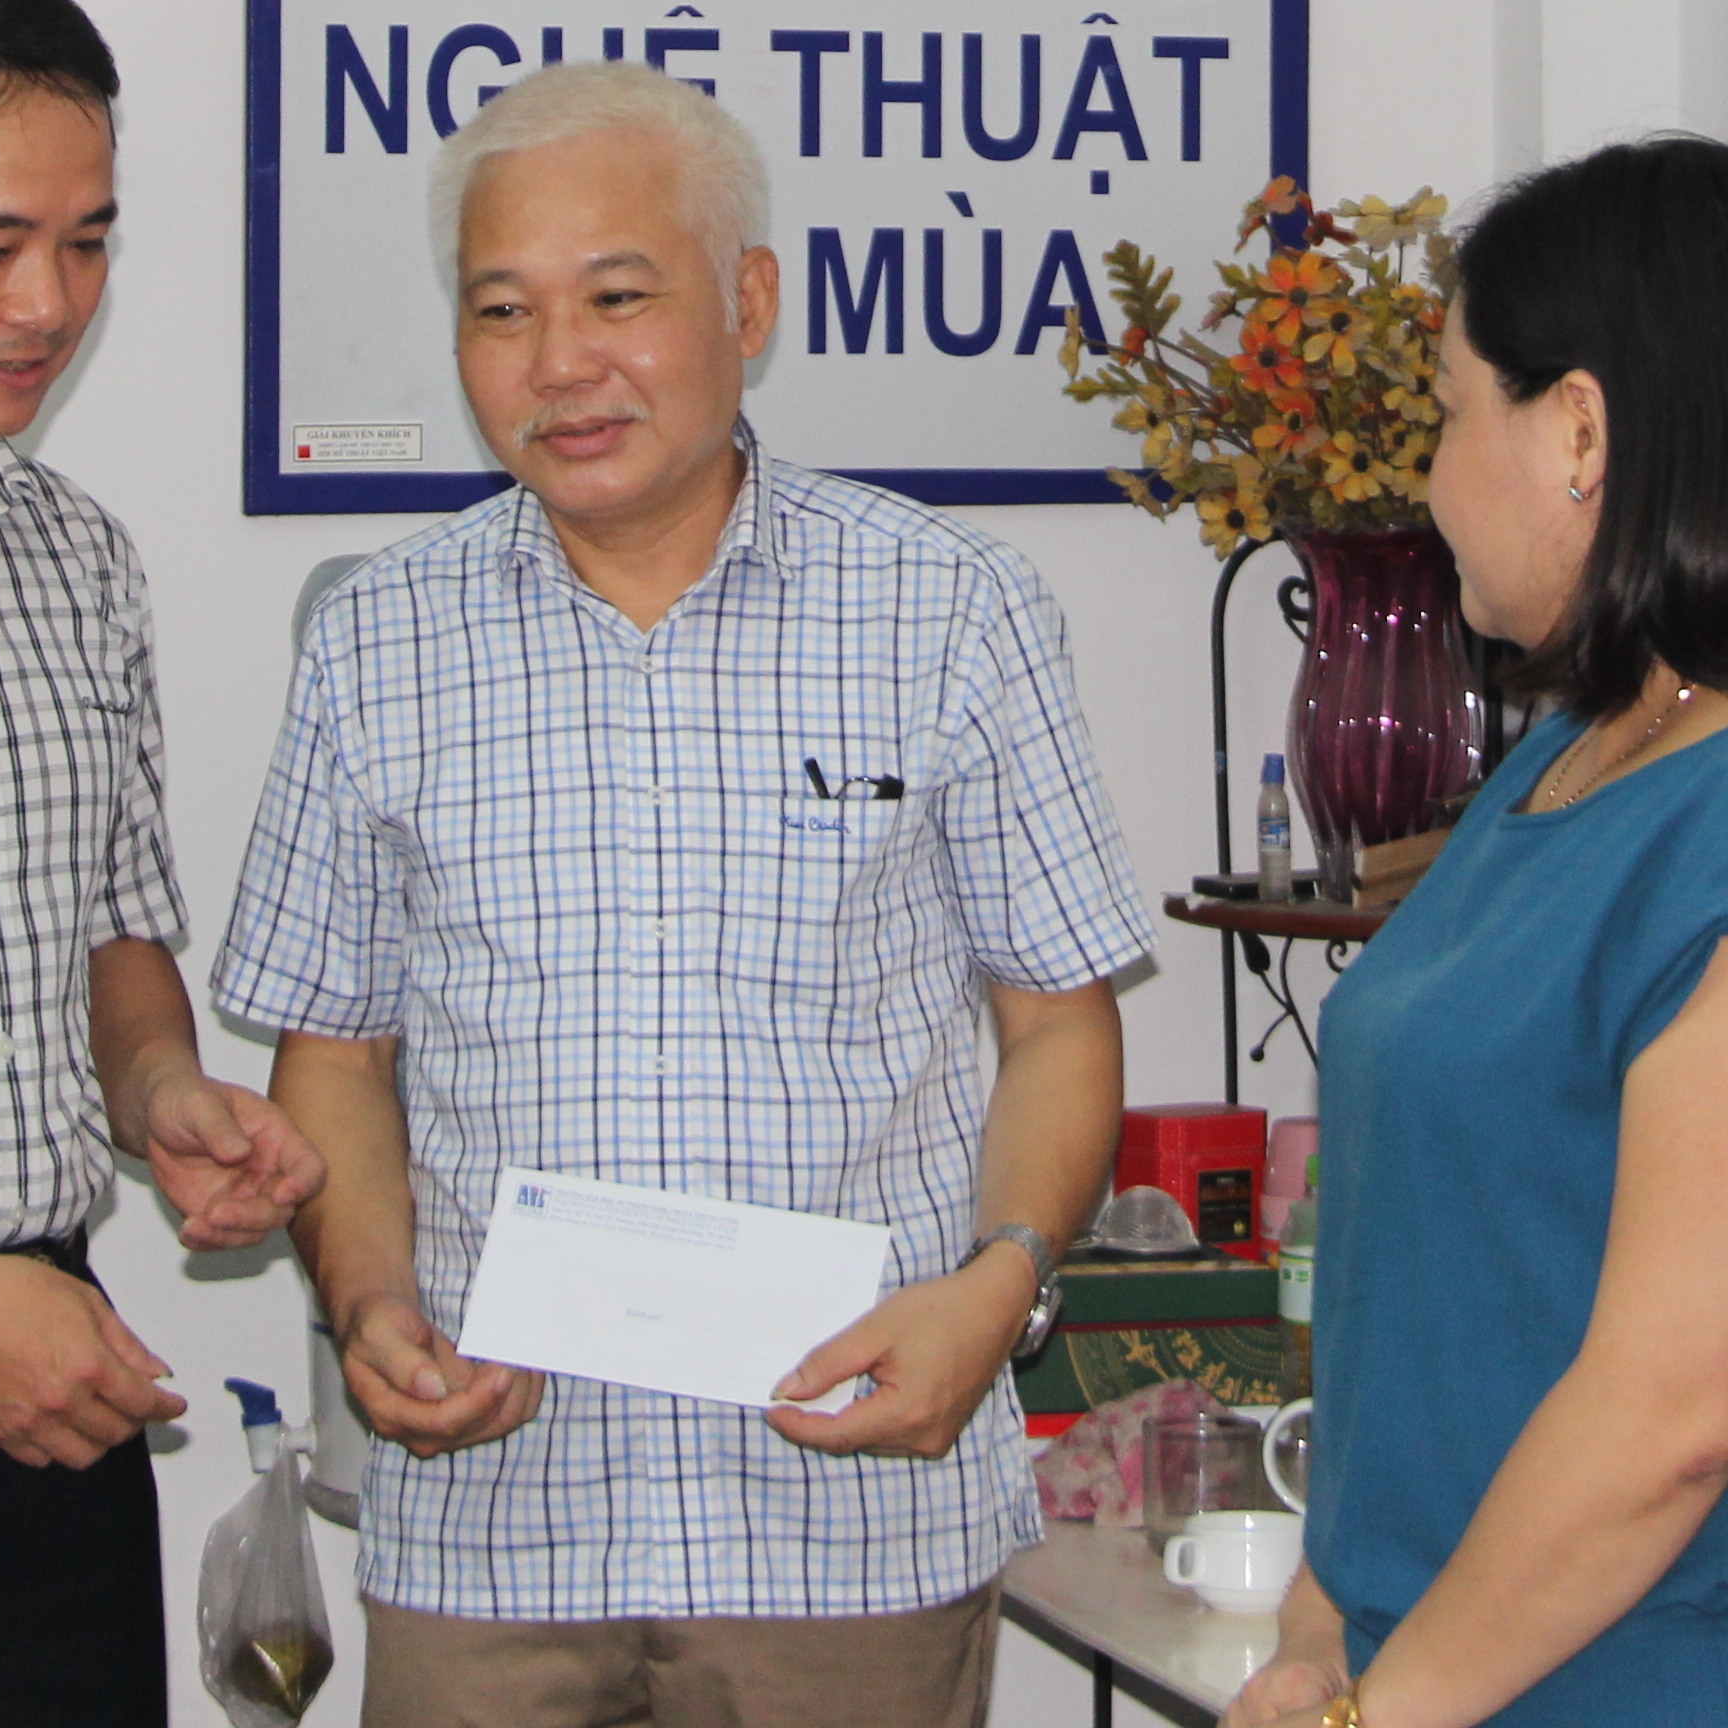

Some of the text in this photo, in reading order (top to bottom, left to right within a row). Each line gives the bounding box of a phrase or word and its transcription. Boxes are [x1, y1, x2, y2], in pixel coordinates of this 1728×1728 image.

[325, 5, 1229, 194] NG THUẬT
[807, 191, 1110, 356] MÙA
